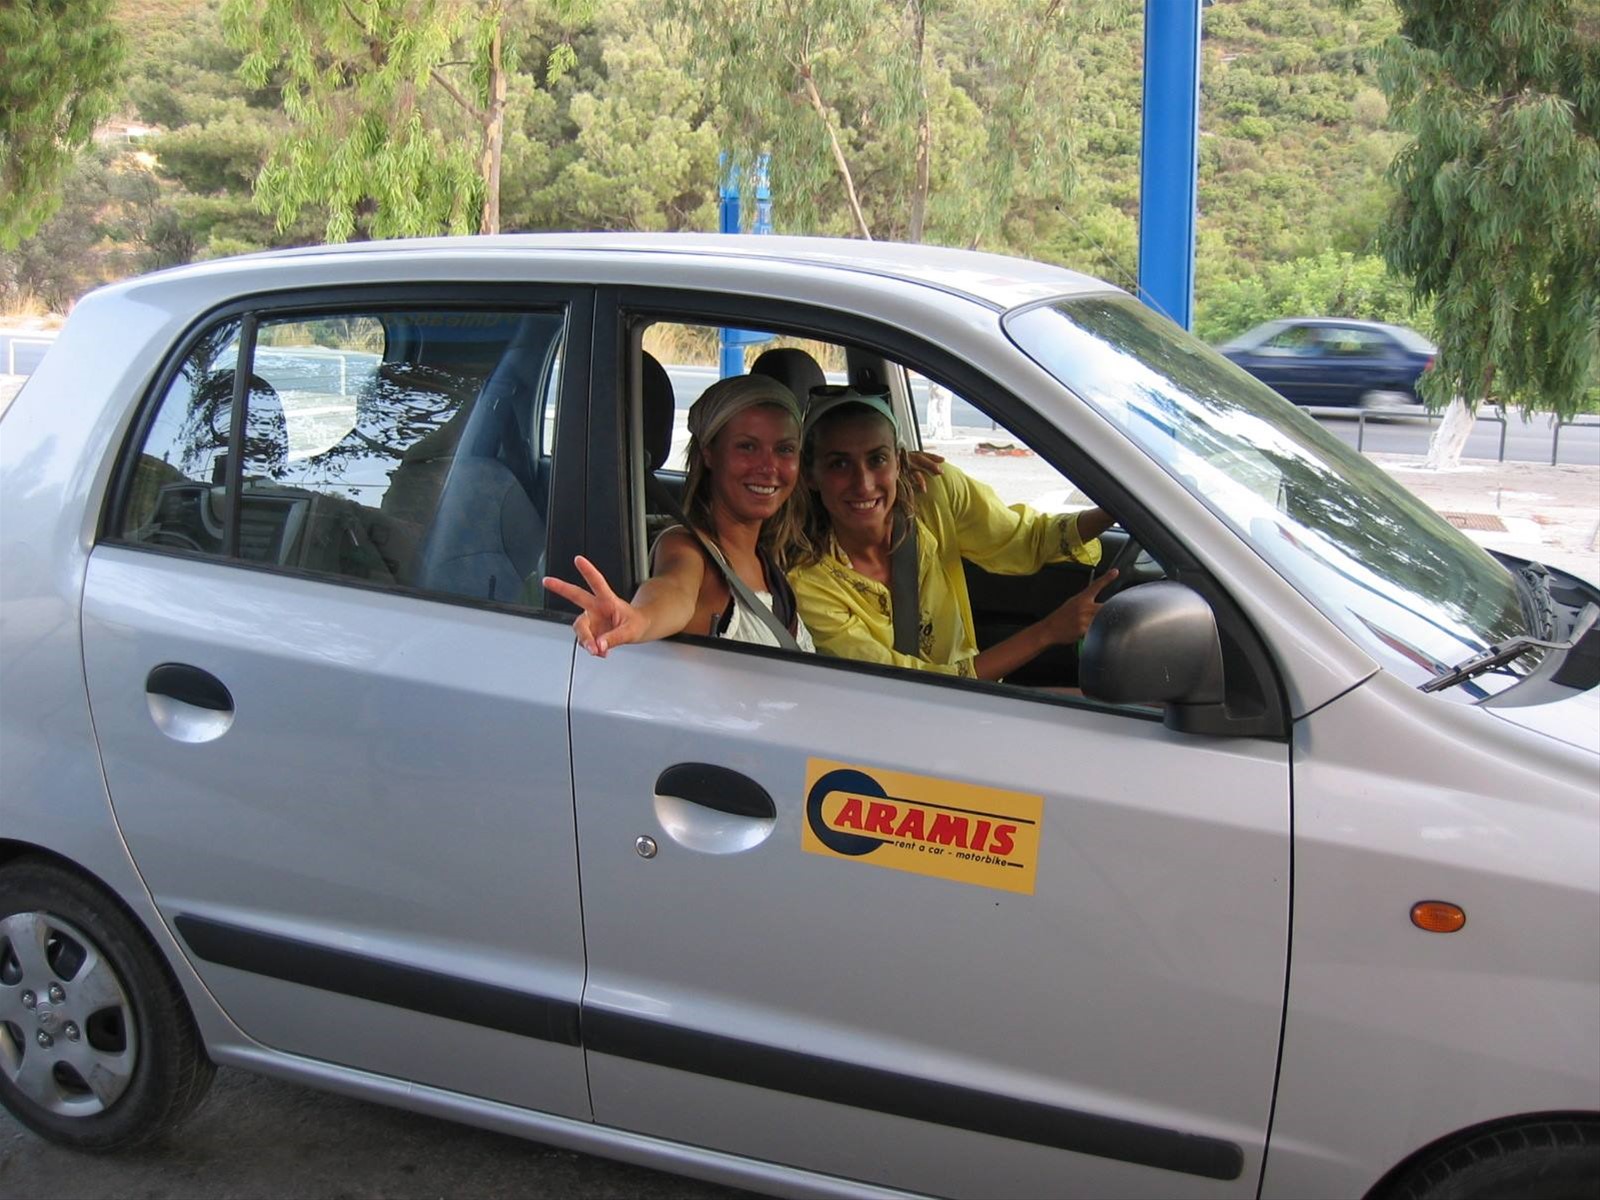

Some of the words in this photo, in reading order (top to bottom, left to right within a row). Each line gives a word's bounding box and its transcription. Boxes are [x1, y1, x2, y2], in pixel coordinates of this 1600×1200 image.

[894, 839, 916, 850] rent
[918, 844, 925, 852] a
[928, 846, 944, 855] car
[955, 850, 1008, 866] motorbike
